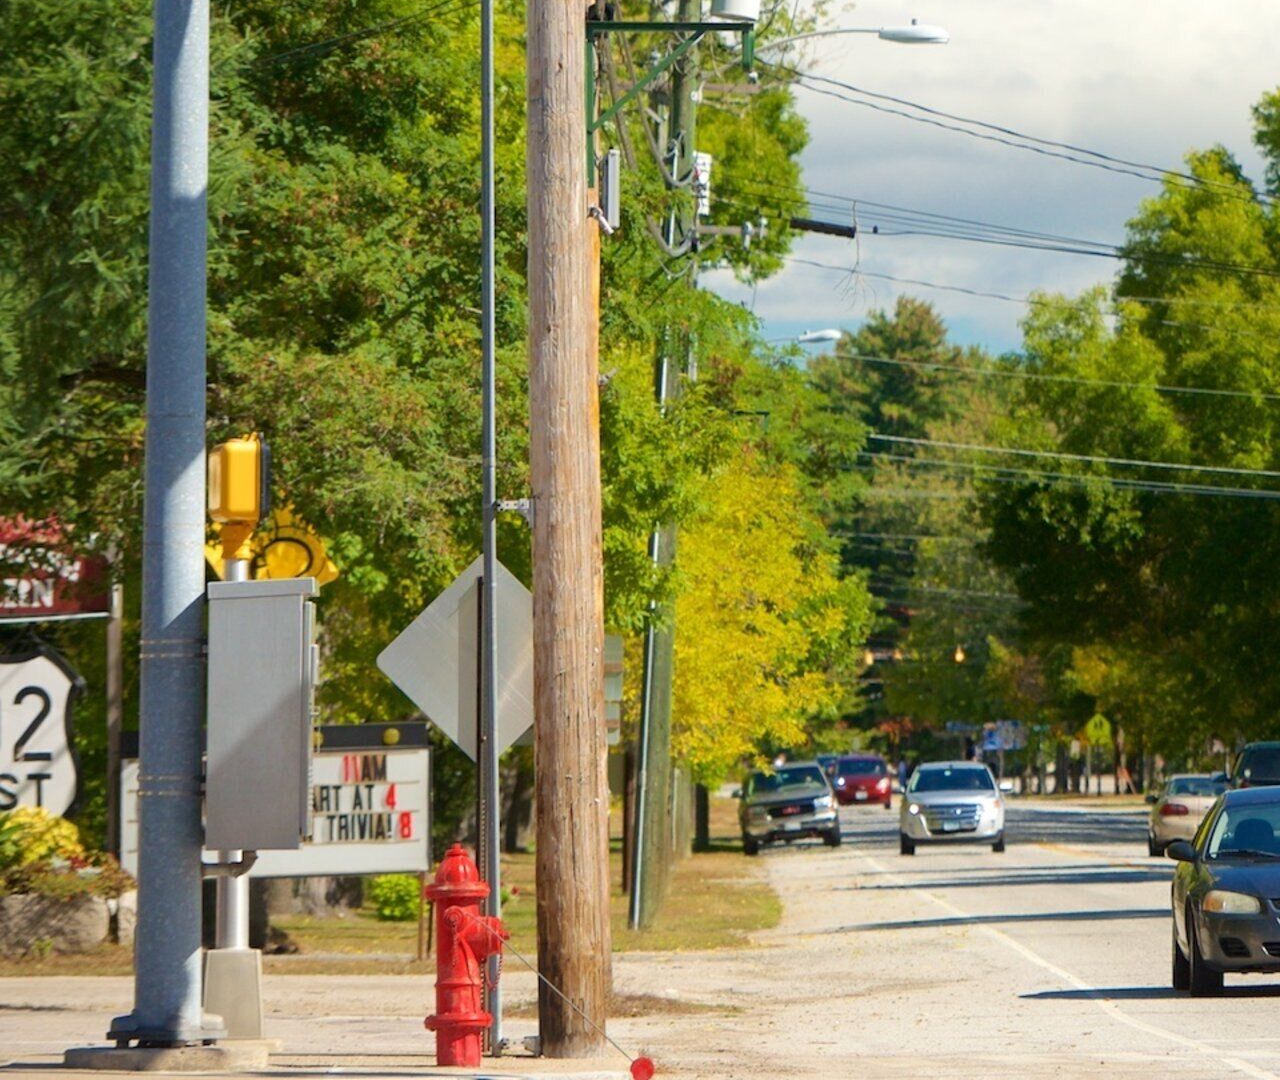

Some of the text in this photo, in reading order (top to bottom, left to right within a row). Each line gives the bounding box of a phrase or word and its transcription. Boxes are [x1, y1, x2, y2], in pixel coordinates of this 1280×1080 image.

[0, 686, 52, 762] 2
[0, 773, 52, 811] ST
[353, 785, 375, 810] AT
[384, 783, 397, 811] 4
[326, 811, 412, 841] TRIVIA! 8
